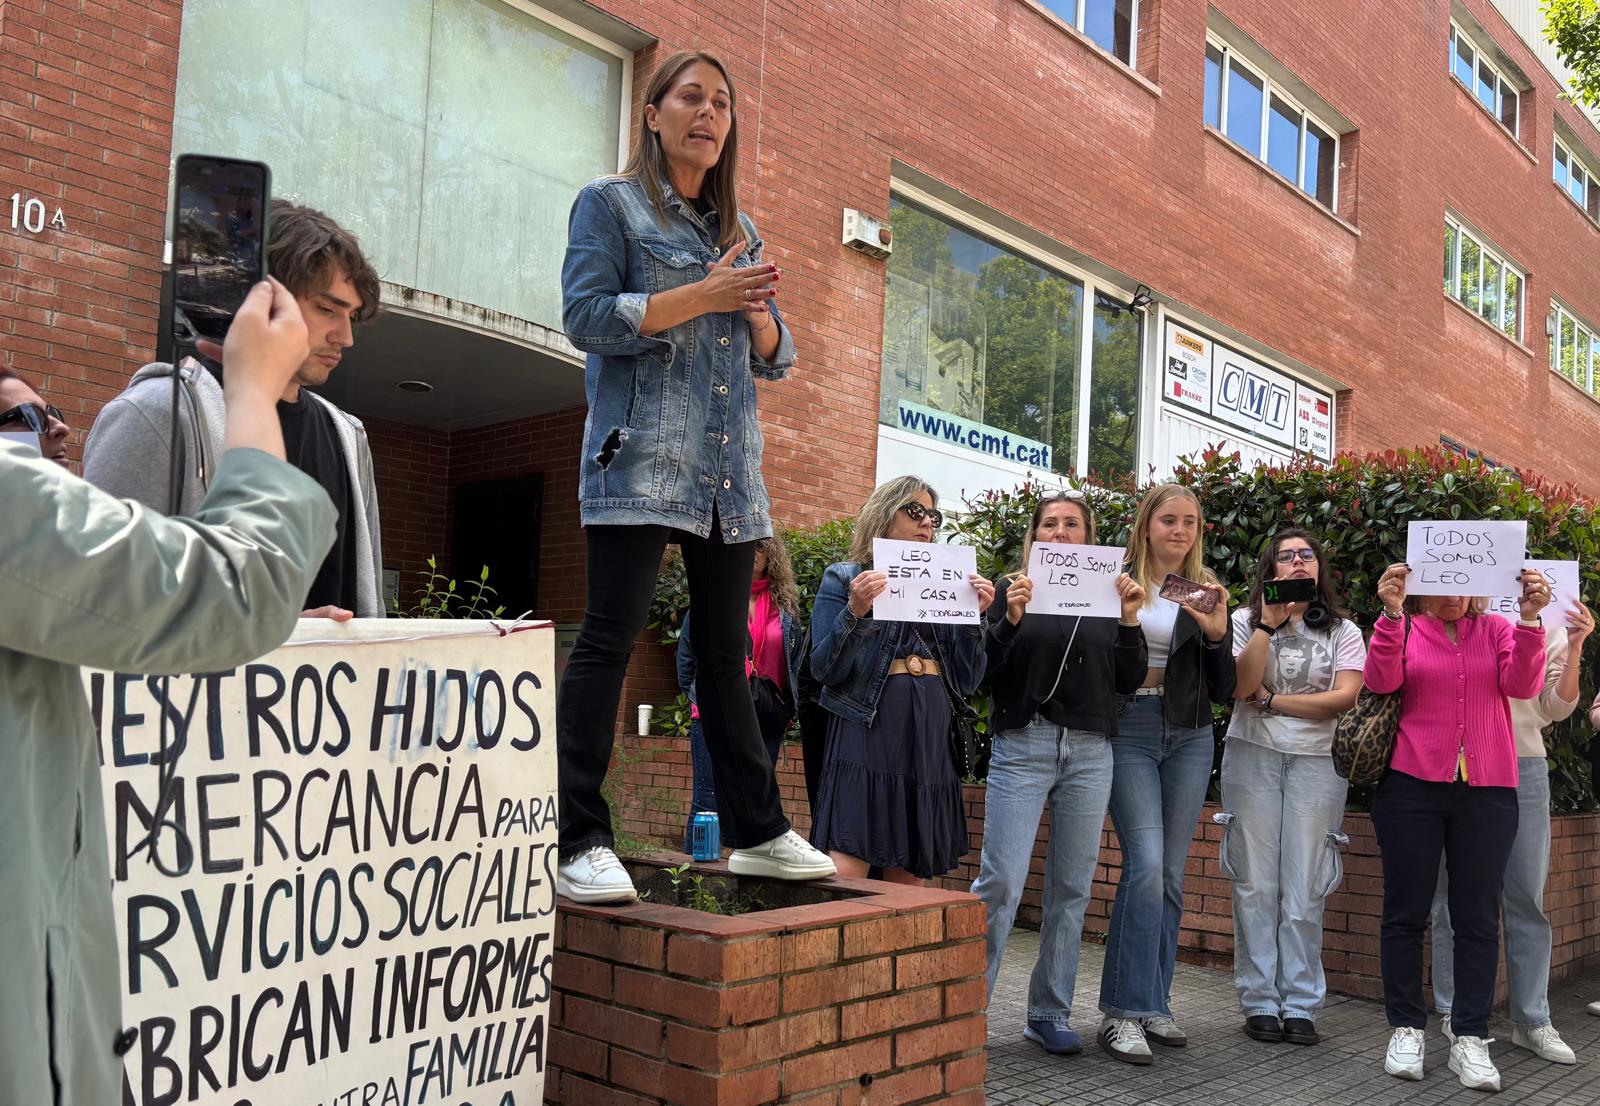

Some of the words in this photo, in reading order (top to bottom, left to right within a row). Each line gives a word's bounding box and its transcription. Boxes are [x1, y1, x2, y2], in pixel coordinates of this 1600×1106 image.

[10, 192, 46, 234] 10
[51, 207, 66, 228] A
[1181, 337, 1203, 352] JUNKERS
[1223, 370, 1288, 423] CMT
[899, 406, 1049, 468] www.cmt.cat
[1421, 526, 1495, 548] TODOS
[901, 549, 932, 563] LEO
[1039, 547, 1079, 568] TODOS
[1082, 556, 1117, 575] SOMOS
[1421, 549, 1497, 566] SOMOS
[888, 565, 931, 579] ESTA
[942, 568, 963, 581] EN
[1048, 568, 1079, 587] LEO
[1420, 568, 1470, 585] LEO
[890, 586, 905, 599] MI
[920, 588, 957, 602] CASA
[369, 667, 542, 752] HIJOS
[491, 795, 558, 838] PARA
[127, 862, 374, 995] RViCiOS
[123, 967, 355, 1106] BRICAN
[369, 932, 553, 1044] INFORMES
[402, 1014, 544, 1106] FAMILIA
